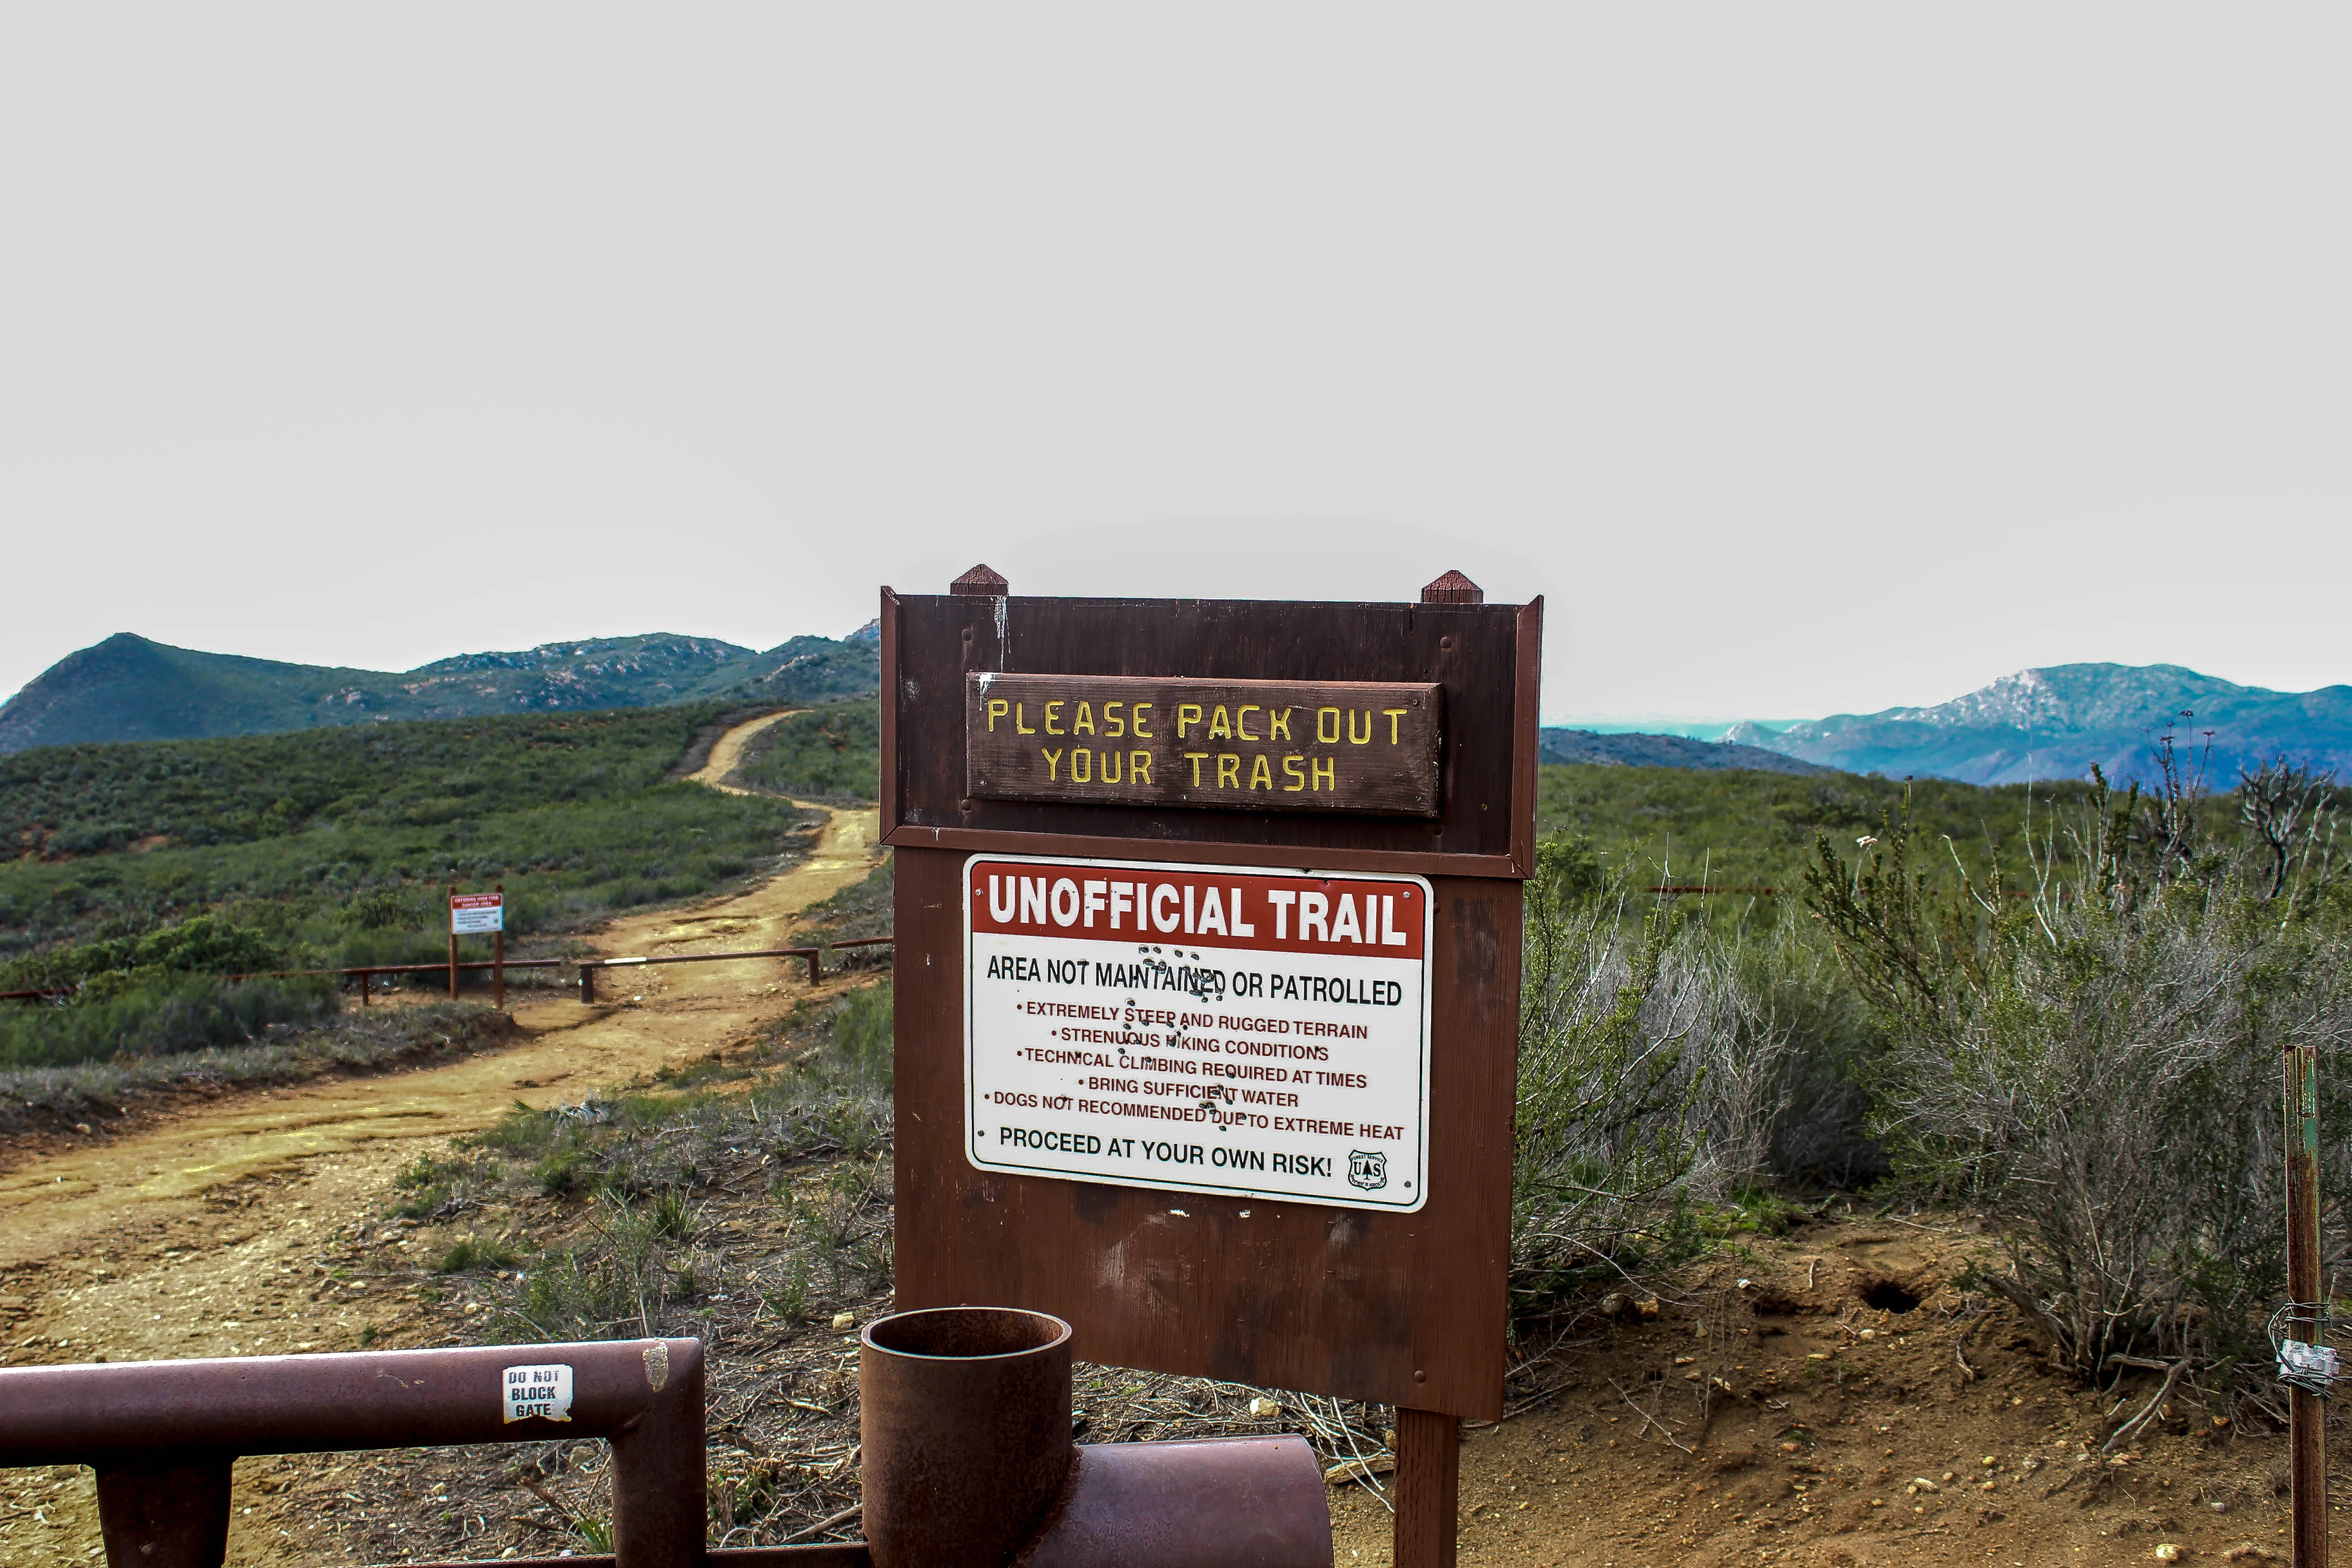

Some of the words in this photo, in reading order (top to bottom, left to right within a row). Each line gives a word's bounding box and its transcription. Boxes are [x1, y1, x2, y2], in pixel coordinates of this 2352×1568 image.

[988, 699, 1154, 739] PLEASE
[1178, 703, 1293, 741] PACK
[1316, 705, 1408, 746] OUT
[1042, 747, 1152, 785] YOUR
[1184, 752, 1335, 792] TRASH
[989, 874, 1255, 938] UNOFFICIAL
[1268, 889, 1407, 946] TRAIL
[986, 955, 1041, 983] AREA
[1047, 958, 1090, 985] NOT
[1095, 962, 1226, 995] MAINTAINED
[1232, 970, 1263, 998] OR
[1270, 973, 1402, 1006] PATROLLED
[1027, 1001, 1120, 1021] EXTREMELY
[1124, 1007, 1176, 1024] STEEP
[1179, 1012, 1213, 1028] AND
[1218, 1015, 1290, 1034] RUGGED
[1293, 1020, 1368, 1039] TERRAIN
[1061, 1027, 1161, 1047] STRENUOUS
[1166, 1034, 1220, 1053] HIKING
[1225, 1040, 1329, 1061] CONDITIONS
[1024, 1048, 1114, 1068] TECHNICAL
[1119, 1055, 1197, 1075] CLIMBING
[1202, 1062, 1288, 1082] REQUIRED
[1292, 1070, 1313, 1085] AT
[1315, 1071, 1367, 1088] TIMES
[1088, 1076, 1138, 1094] BRING
[1143, 1081, 1238, 1102] SUFFICIENT
[1241, 1089, 1298, 1107] WATER
[994, 1091, 1038, 1108] DOGS
[1042, 1096, 1074, 1111] NOT
[1078, 1098, 1206, 1122] RECOMMENDED
[1211, 1109, 1246, 1126] DUE
[1247, 1113, 1269, 1129] TO
[1274, 1116, 1354, 1137] EXTREME
[1359, 1123, 1405, 1141] HEAT
[1000, 1126, 1102, 1155] PROCEED
[1107, 1137, 1135, 1158] AT
[1141, 1140, 1204, 1165] YOUR
[1211, 1146, 1265, 1171] OWN
[1272, 1152, 1332, 1178] RISK!
[1367, 1155, 1384, 1163] SERVICE
[509, 1372, 527, 1384] DO
[533, 1370, 559, 1382] NOT
[511, 1386, 556, 1401] BLOCK
[515, 1403, 552, 1417] GATE
